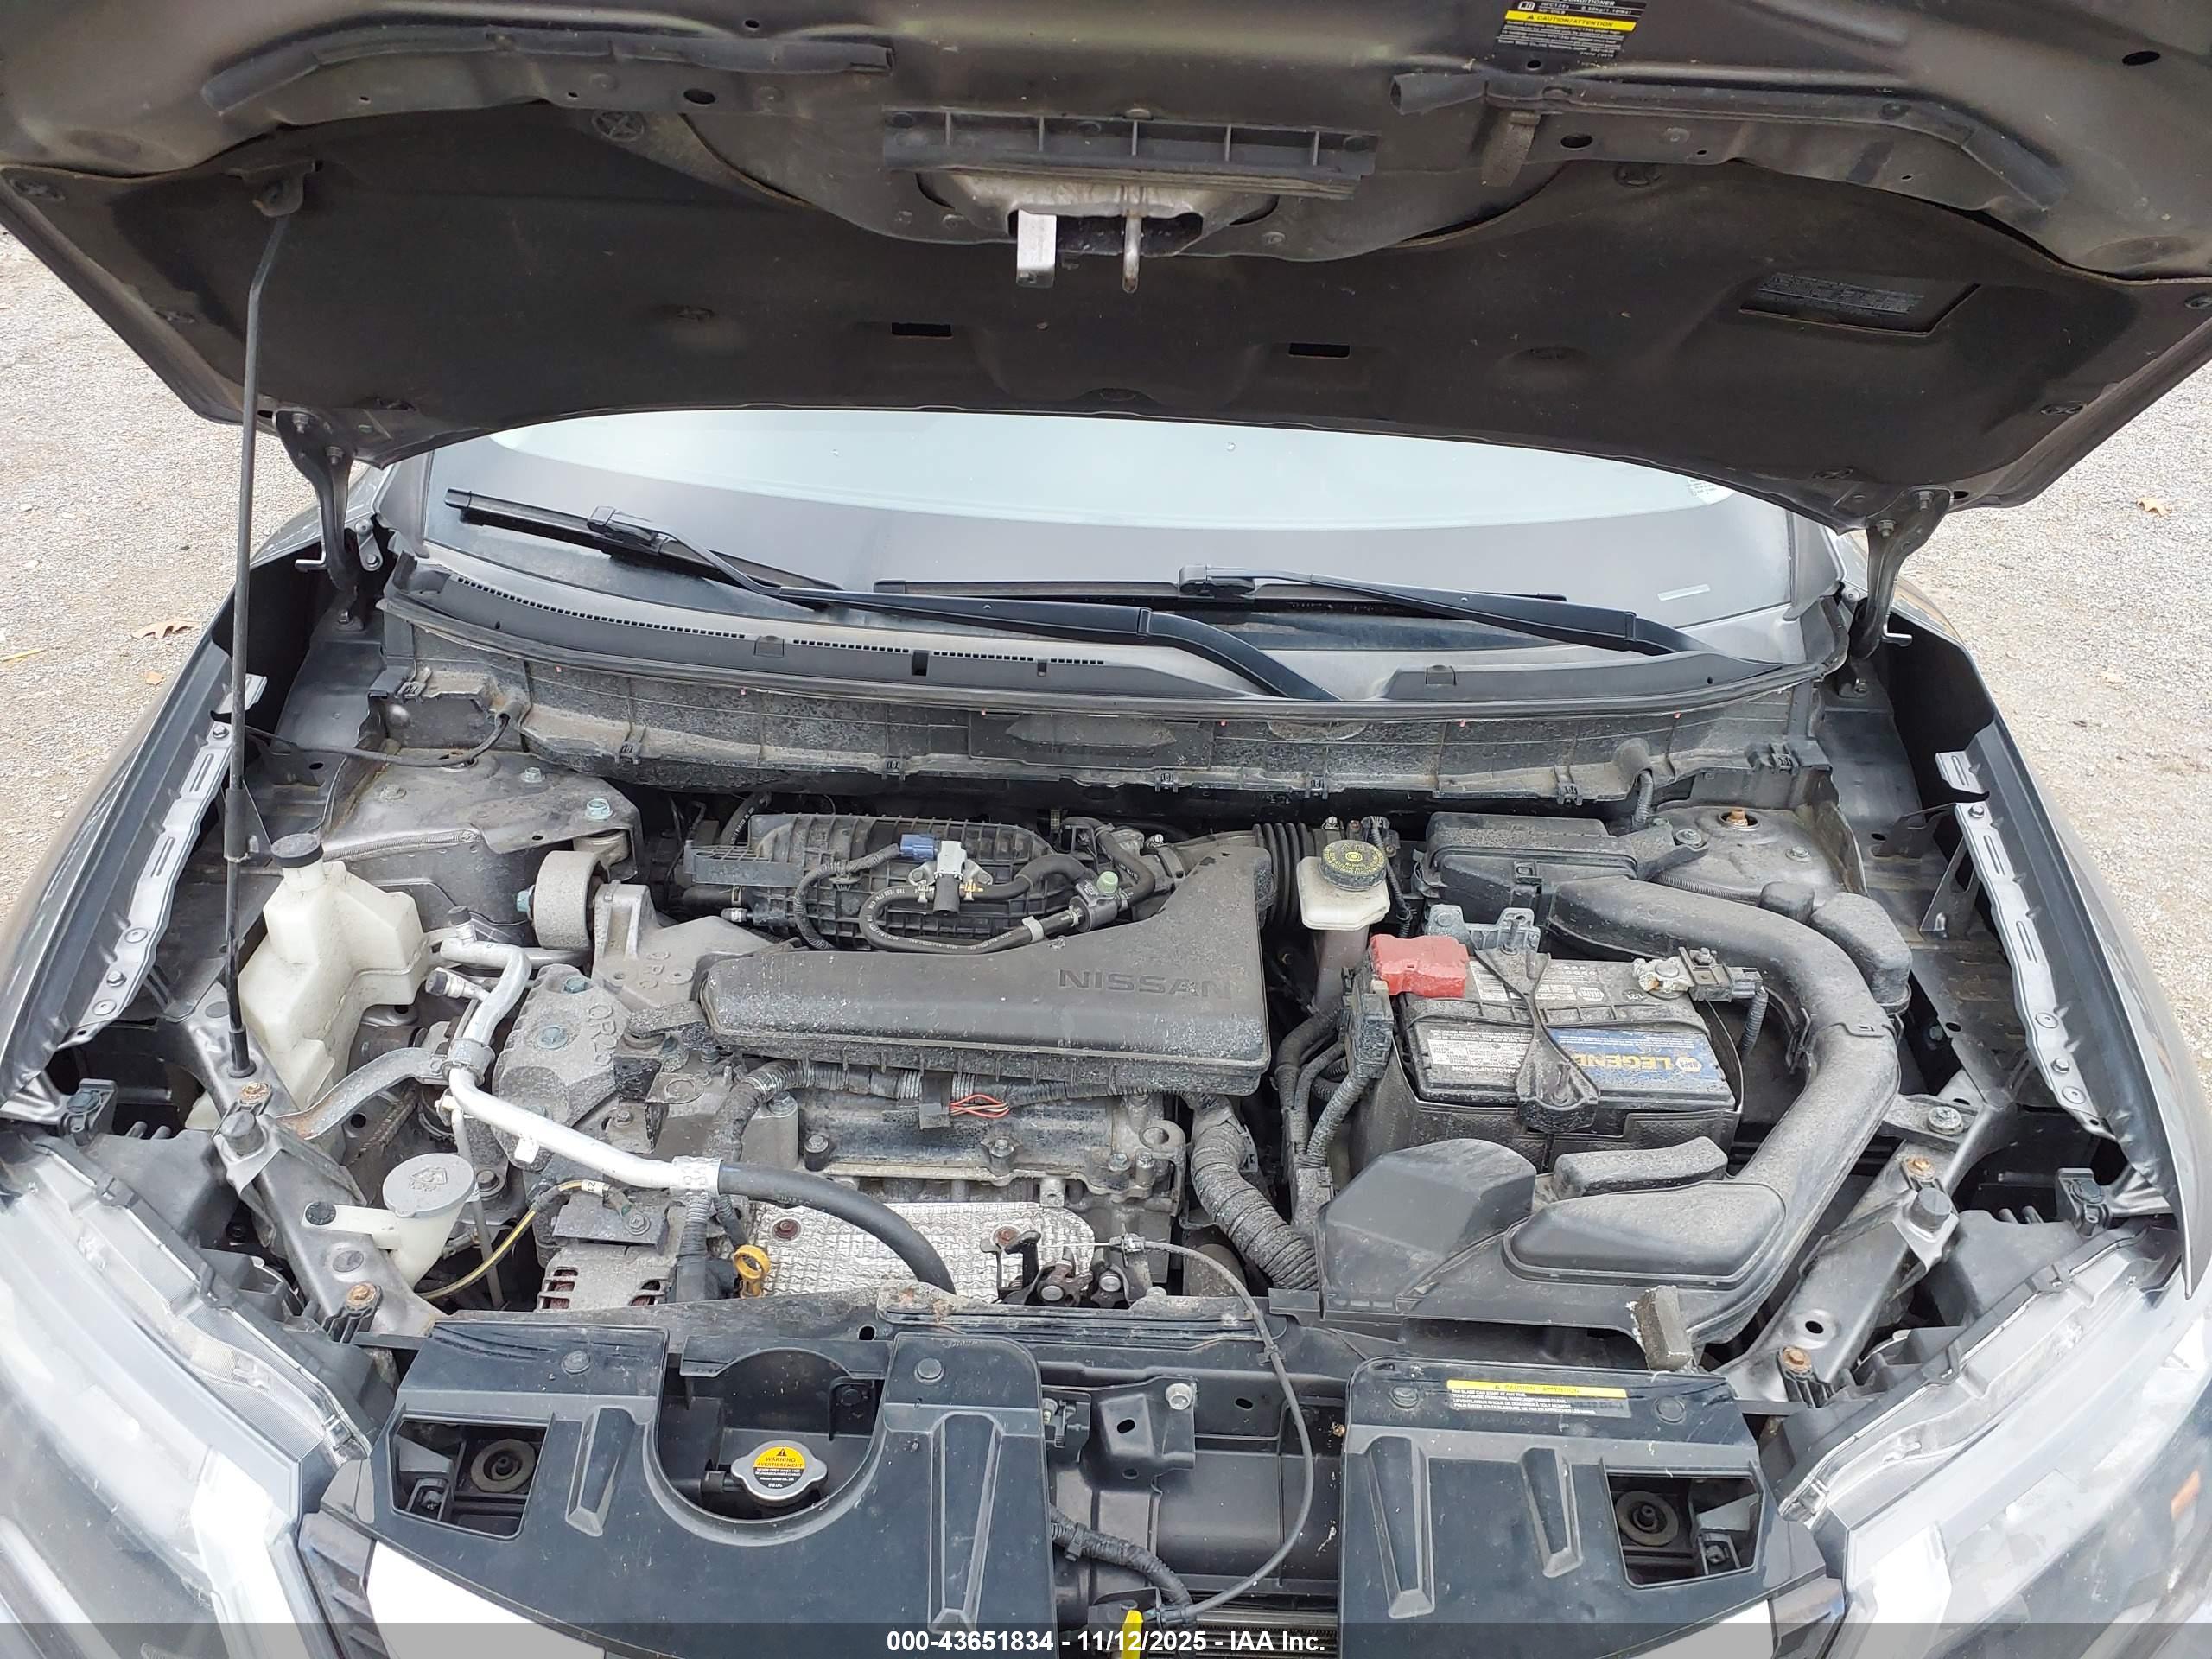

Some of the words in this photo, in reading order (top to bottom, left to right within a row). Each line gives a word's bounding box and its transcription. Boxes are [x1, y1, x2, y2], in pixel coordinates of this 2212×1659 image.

[1537, 15, 1614, 27] CAUTION/ATTENTION
[1058, 969, 1231, 1000] NISSAN
[1452, 1065, 1519, 1074] ANGER/POISON
[1571, 1053, 1674, 1071] LEGEND
